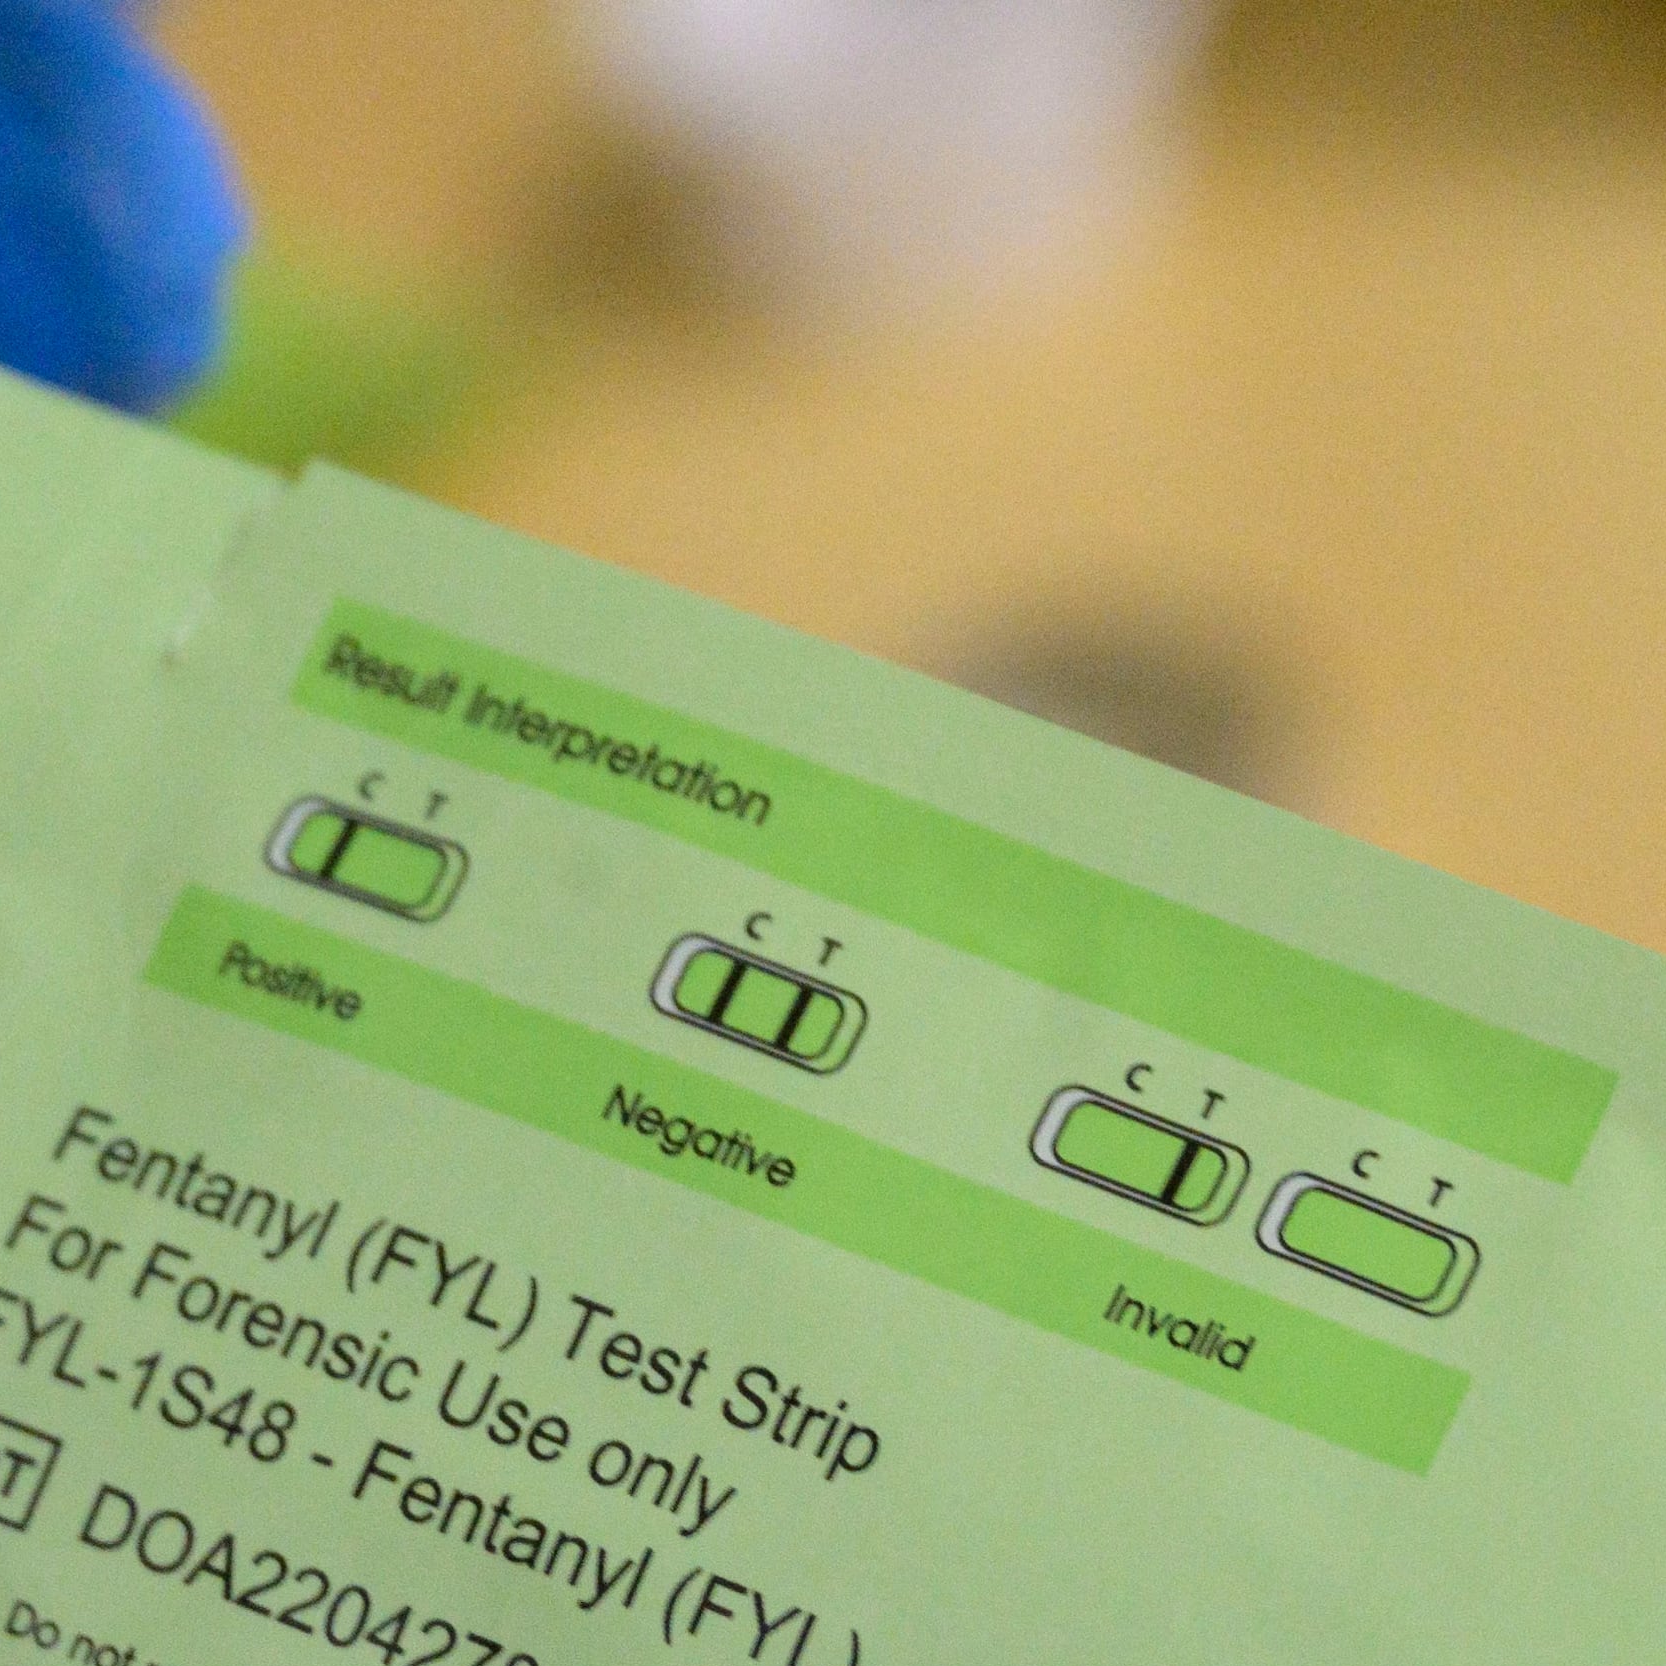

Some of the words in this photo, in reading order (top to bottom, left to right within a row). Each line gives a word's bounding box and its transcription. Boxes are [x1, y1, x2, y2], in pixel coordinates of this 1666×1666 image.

[323, 633, 460, 716] Result
[463, 684, 772, 827] Interpretation
[358, 770, 385, 801] C
[425, 789, 449, 820] T
[219, 940, 364, 1022] Positive
[745, 911, 773, 940] C
[817, 937, 843, 967] T
[1125, 1063, 1153, 1094] C
[1200, 1089, 1226, 1119] T
[602, 1084, 798, 1191] Negative
[1352, 1149, 1380, 1178] C
[1427, 1176, 1454, 1208] T
[52, 1105, 342, 1261] Fentanyl
[345, 1218, 542, 1353] (FYL)
[560, 1294, 710, 1405] Test
[720, 1366, 881, 1481] Strip
[1103, 1283, 1256, 1374] Invalid
[5, 1193, 123, 1280] For
[132, 1241, 421, 1403] Forensic
[437, 1360, 571, 1462] Use
[589, 1439, 738, 1538] only
[310, 1451, 333, 1470] -
[353, 1441, 653, 1611] Fentanyl
[5, 1600, 59, 1650] Do
